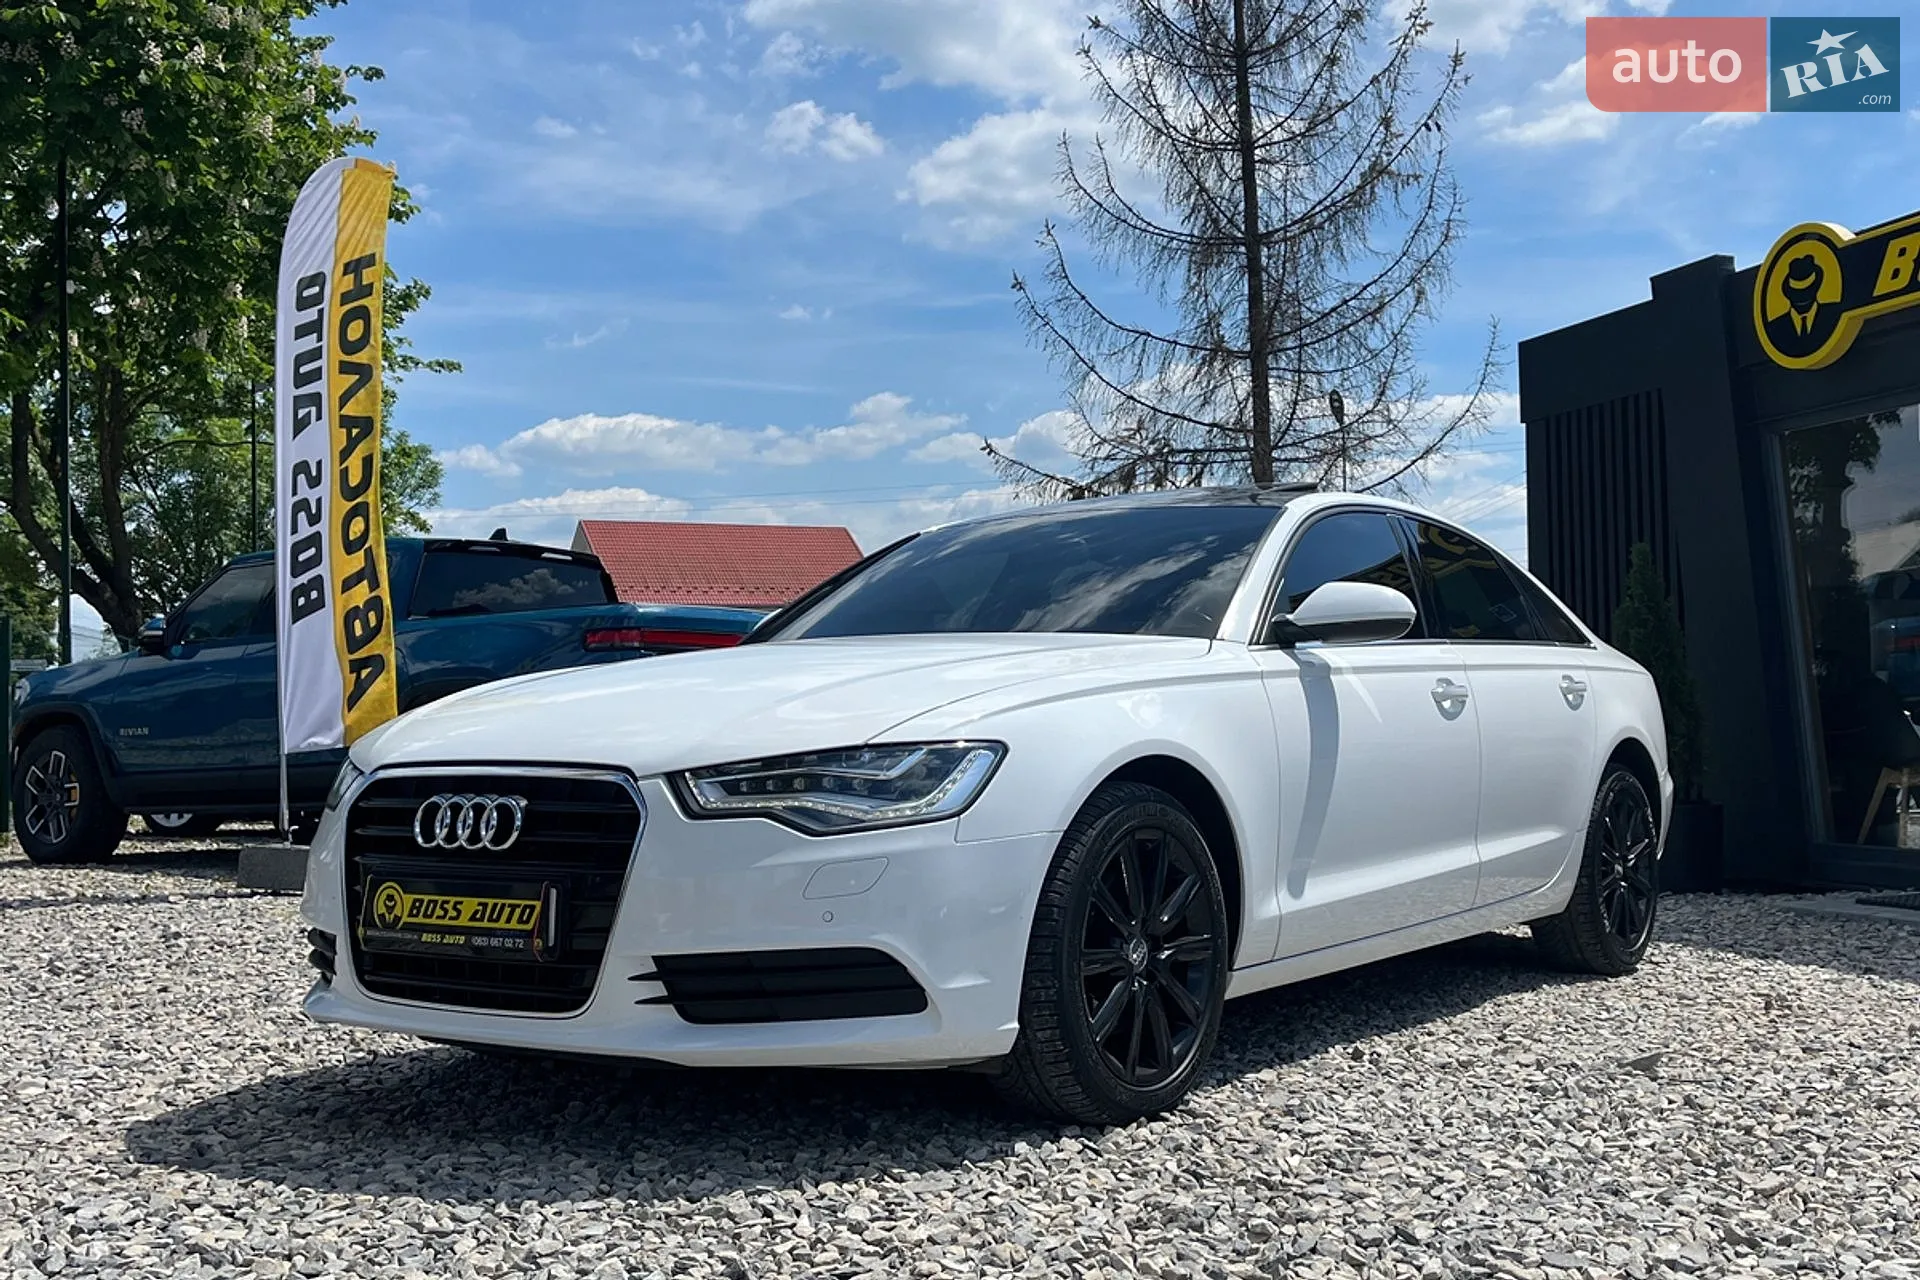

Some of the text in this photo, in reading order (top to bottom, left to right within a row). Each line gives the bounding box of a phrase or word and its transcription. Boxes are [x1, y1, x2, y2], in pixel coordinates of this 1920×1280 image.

[1872, 231, 1920, 297] B
[407, 898, 537, 925] BOSS AUTO
